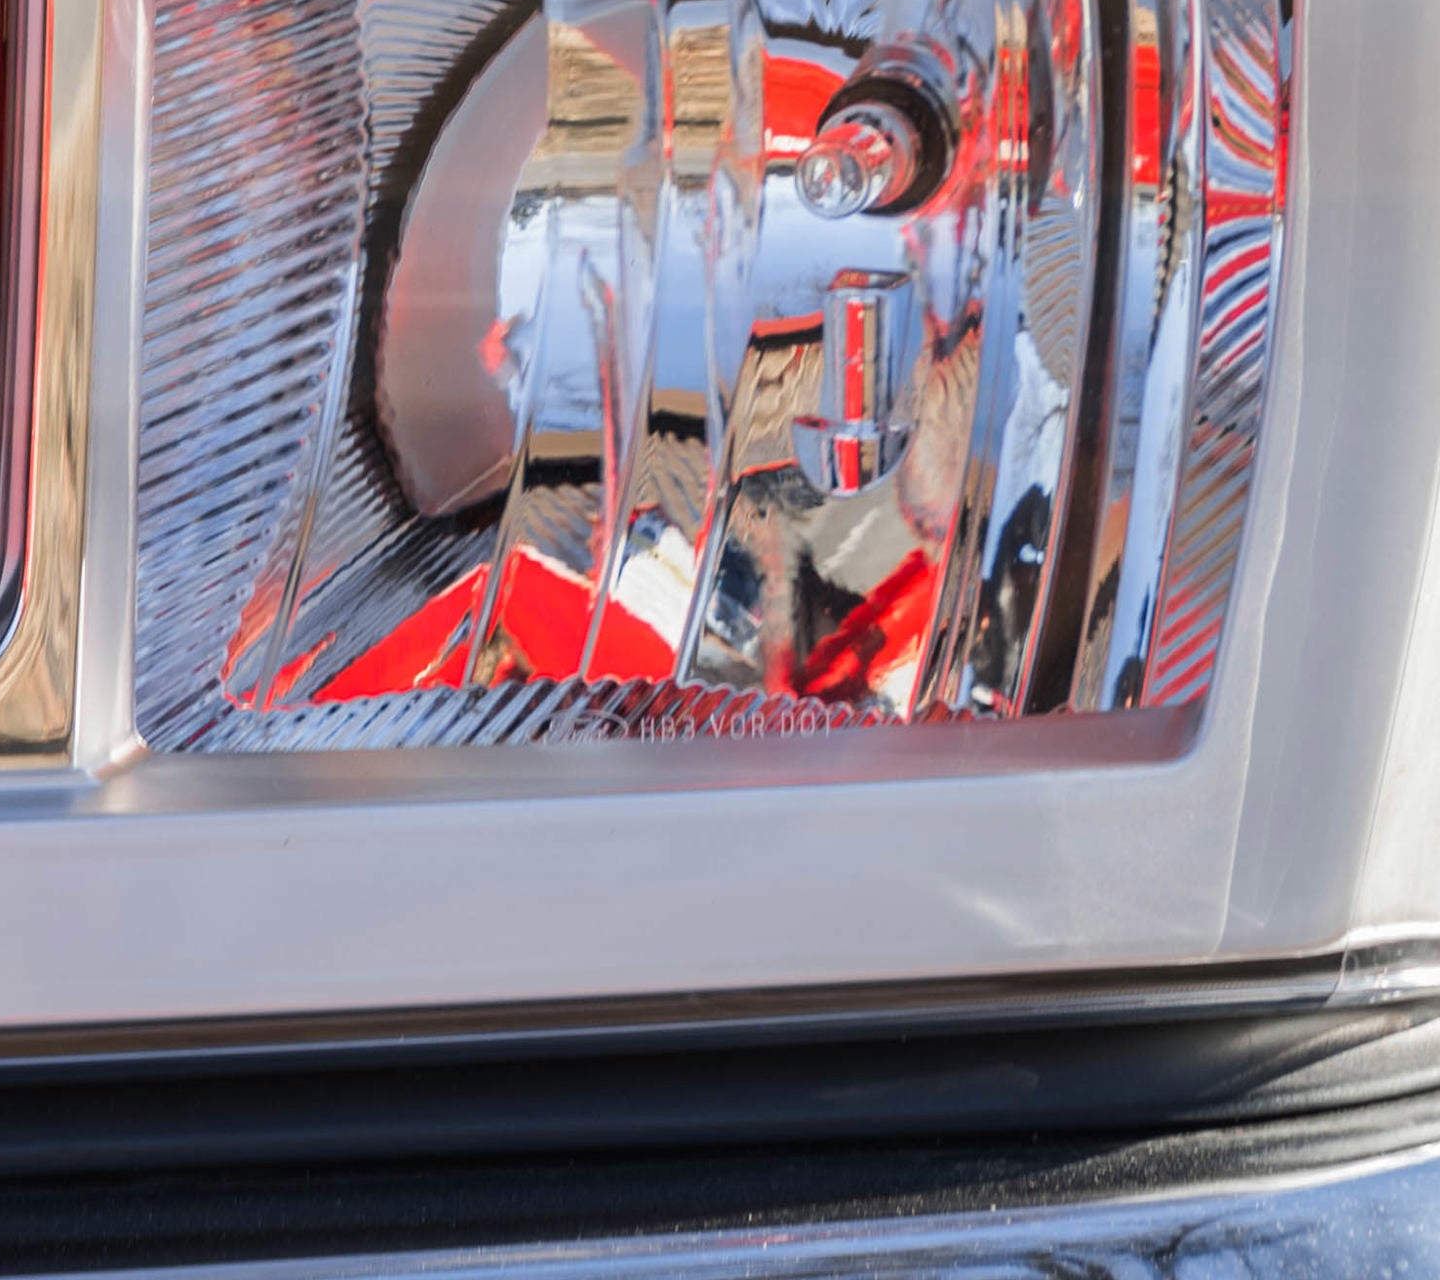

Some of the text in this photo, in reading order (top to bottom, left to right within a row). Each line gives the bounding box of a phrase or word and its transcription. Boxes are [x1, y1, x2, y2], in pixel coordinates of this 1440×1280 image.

[640, 714, 696, 744] HB3
[710, 711, 766, 740] VOR
[780, 708, 833, 739] DOT
